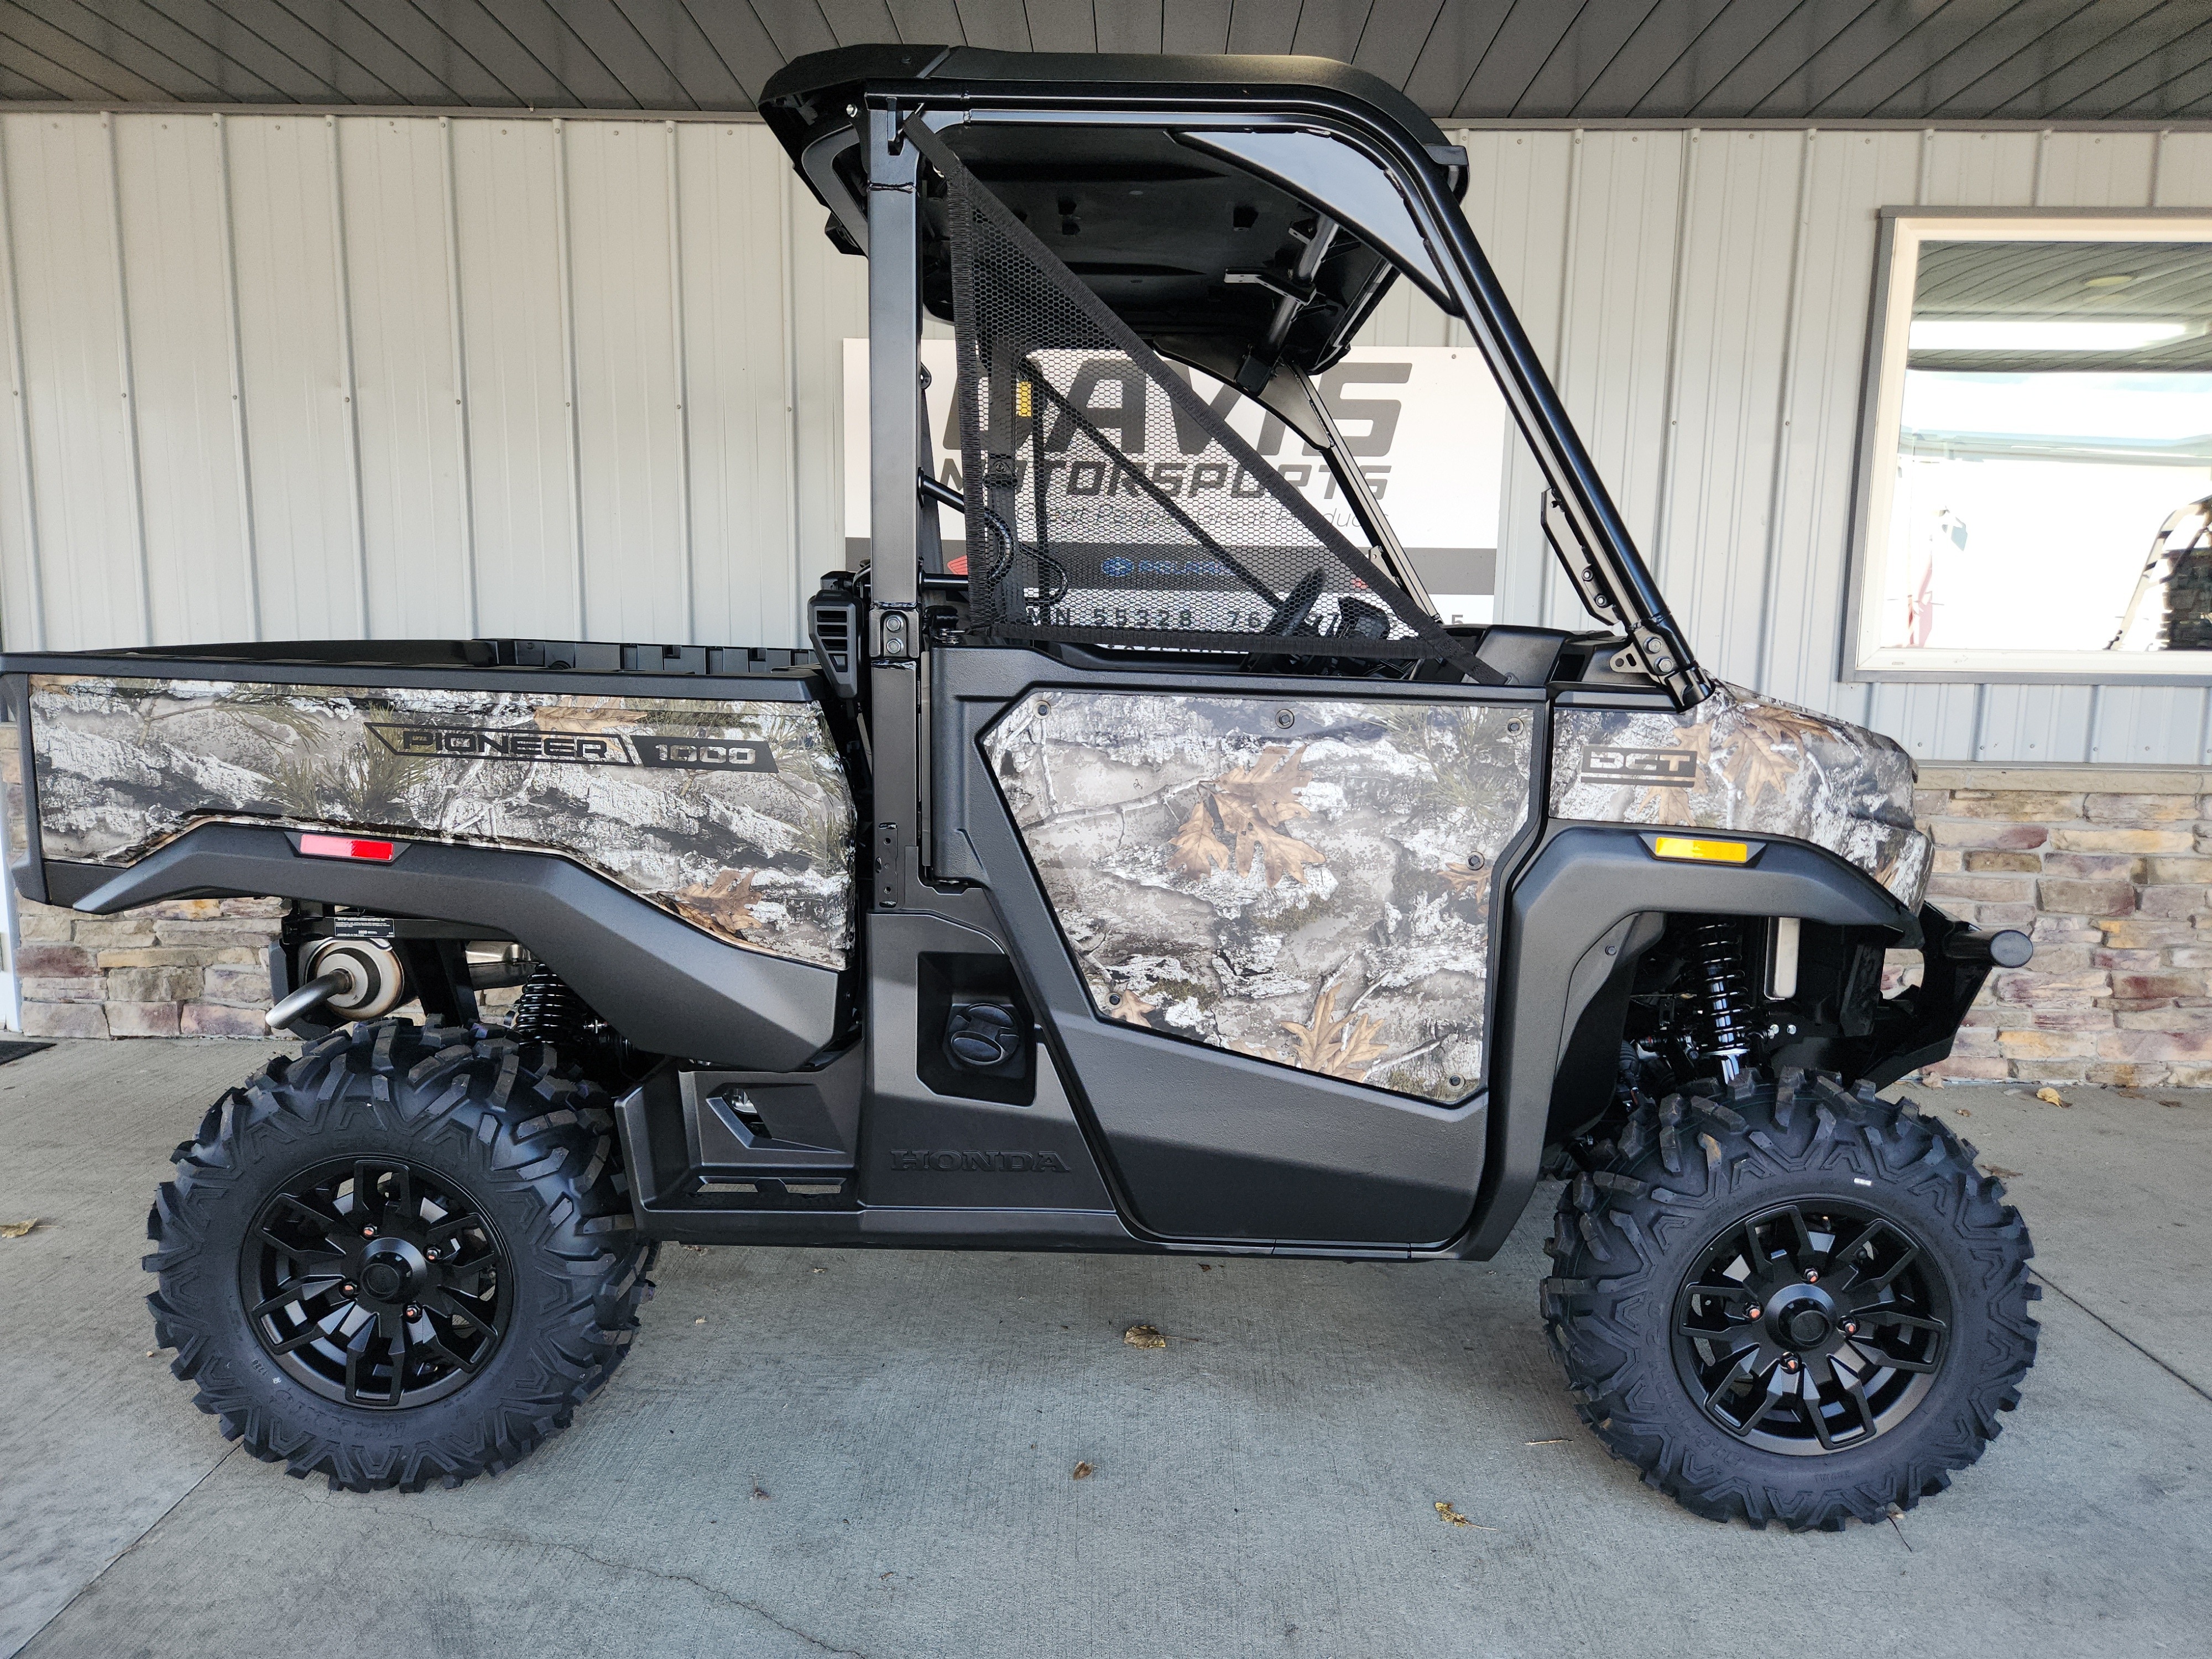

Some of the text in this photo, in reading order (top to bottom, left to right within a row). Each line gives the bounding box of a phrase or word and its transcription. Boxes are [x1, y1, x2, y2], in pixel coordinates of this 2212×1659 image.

[940, 458, 1392, 500] MTORSPORTS
[403, 731, 757, 765] PIONEER 1000
[1590, 751, 1691, 772] DCT
[890, 1149, 1071, 1173] HONDA
